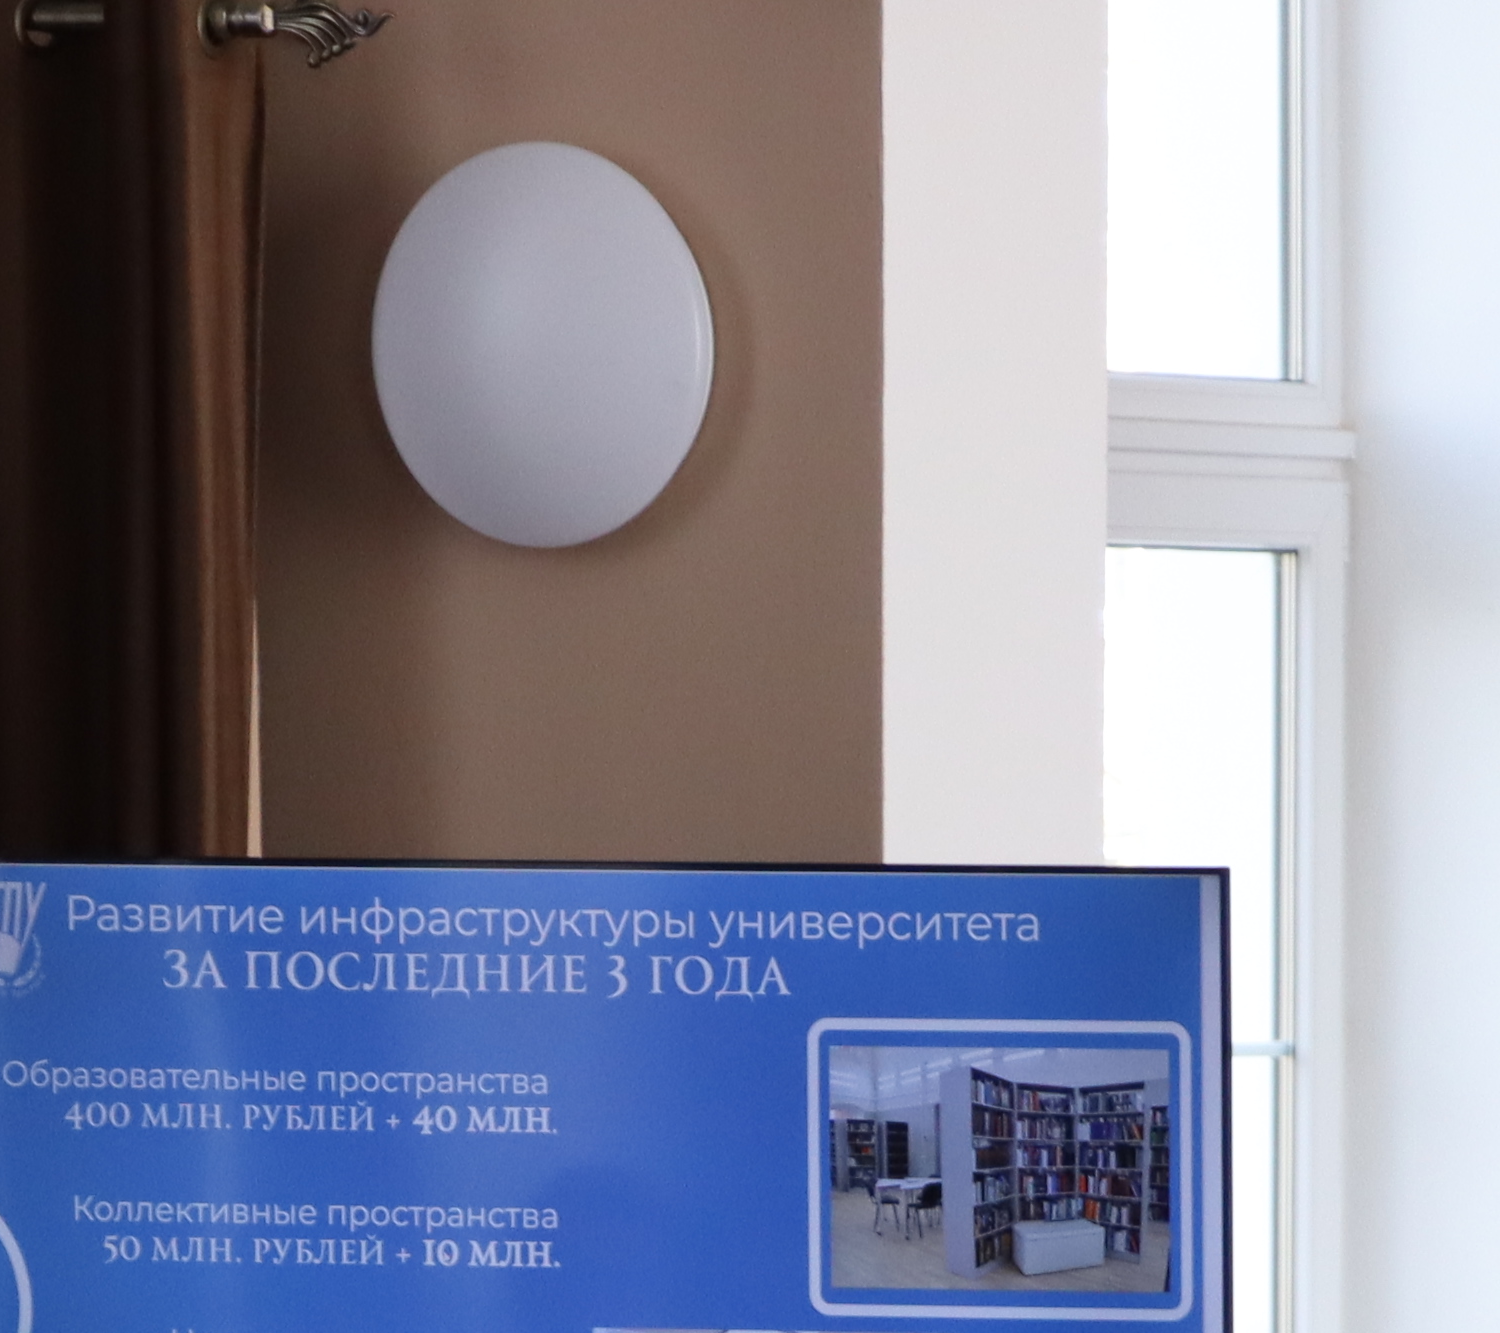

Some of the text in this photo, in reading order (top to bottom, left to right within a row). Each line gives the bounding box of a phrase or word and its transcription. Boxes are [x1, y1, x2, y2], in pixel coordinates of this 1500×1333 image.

[66, 894, 1041, 948] Развитие инфраструктуры университета
[162, 948, 792, 1002] ЗА ПОСЛЕДНИЕ 3 ГОДА
[2, 1060, 548, 1098] Образовательные пространства
[65, 1100, 558, 1135] 400 МЛН. РУБЛЕЙ + 40 МЛН.
[74, 1196, 559, 1232] Коллективные пространства
[103, 1235, 141, 1264] 50
[152, 1237, 241, 1264] МЛН.
[253, 1234, 384, 1265] РУБЛЕЙ
[396, 1248, 411, 1263] +
[468, 1240, 561, 1268] МЛН.
